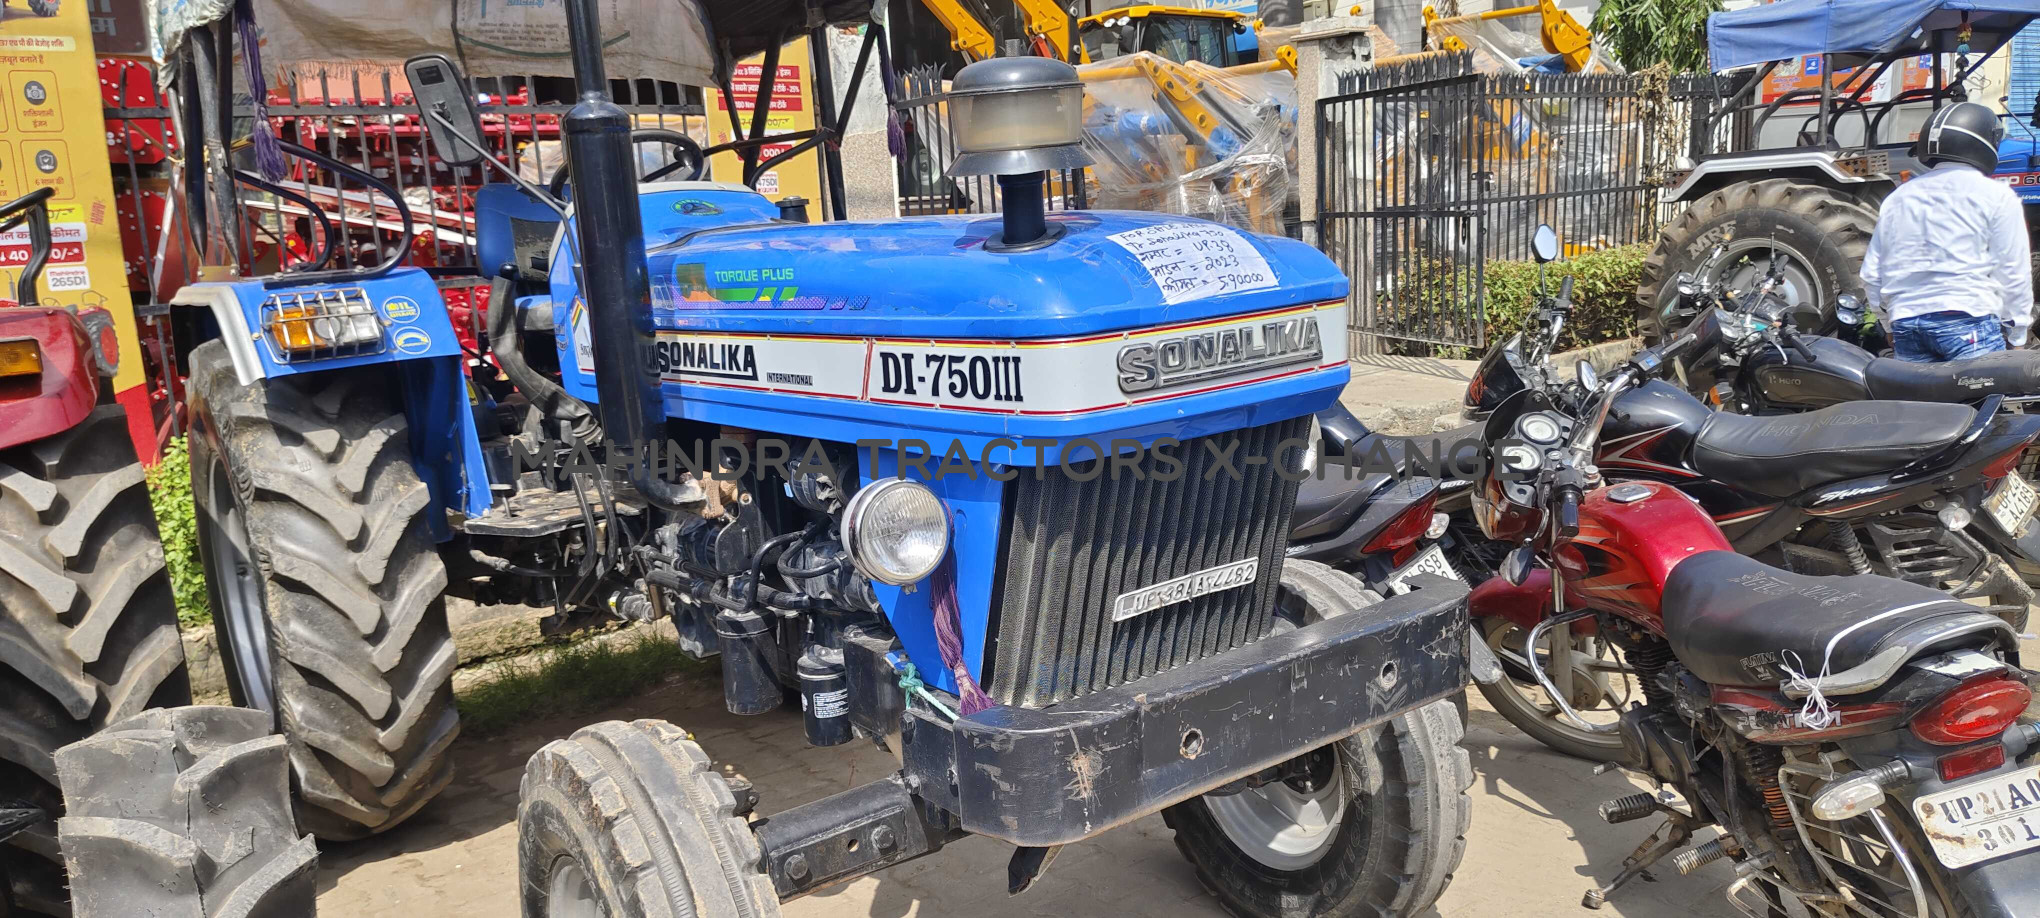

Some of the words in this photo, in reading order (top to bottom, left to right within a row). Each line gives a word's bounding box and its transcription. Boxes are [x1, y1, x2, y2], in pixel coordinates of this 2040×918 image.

[51, 276, 87, 287] 265DI
[715, 270, 759, 283] TORQUE
[761, 268, 794, 281] PLUS
[657, 341, 758, 381] SONALIKA
[1117, 316, 1324, 393] SONALIKA
[766, 371, 813, 386] INTERNATIONAL
